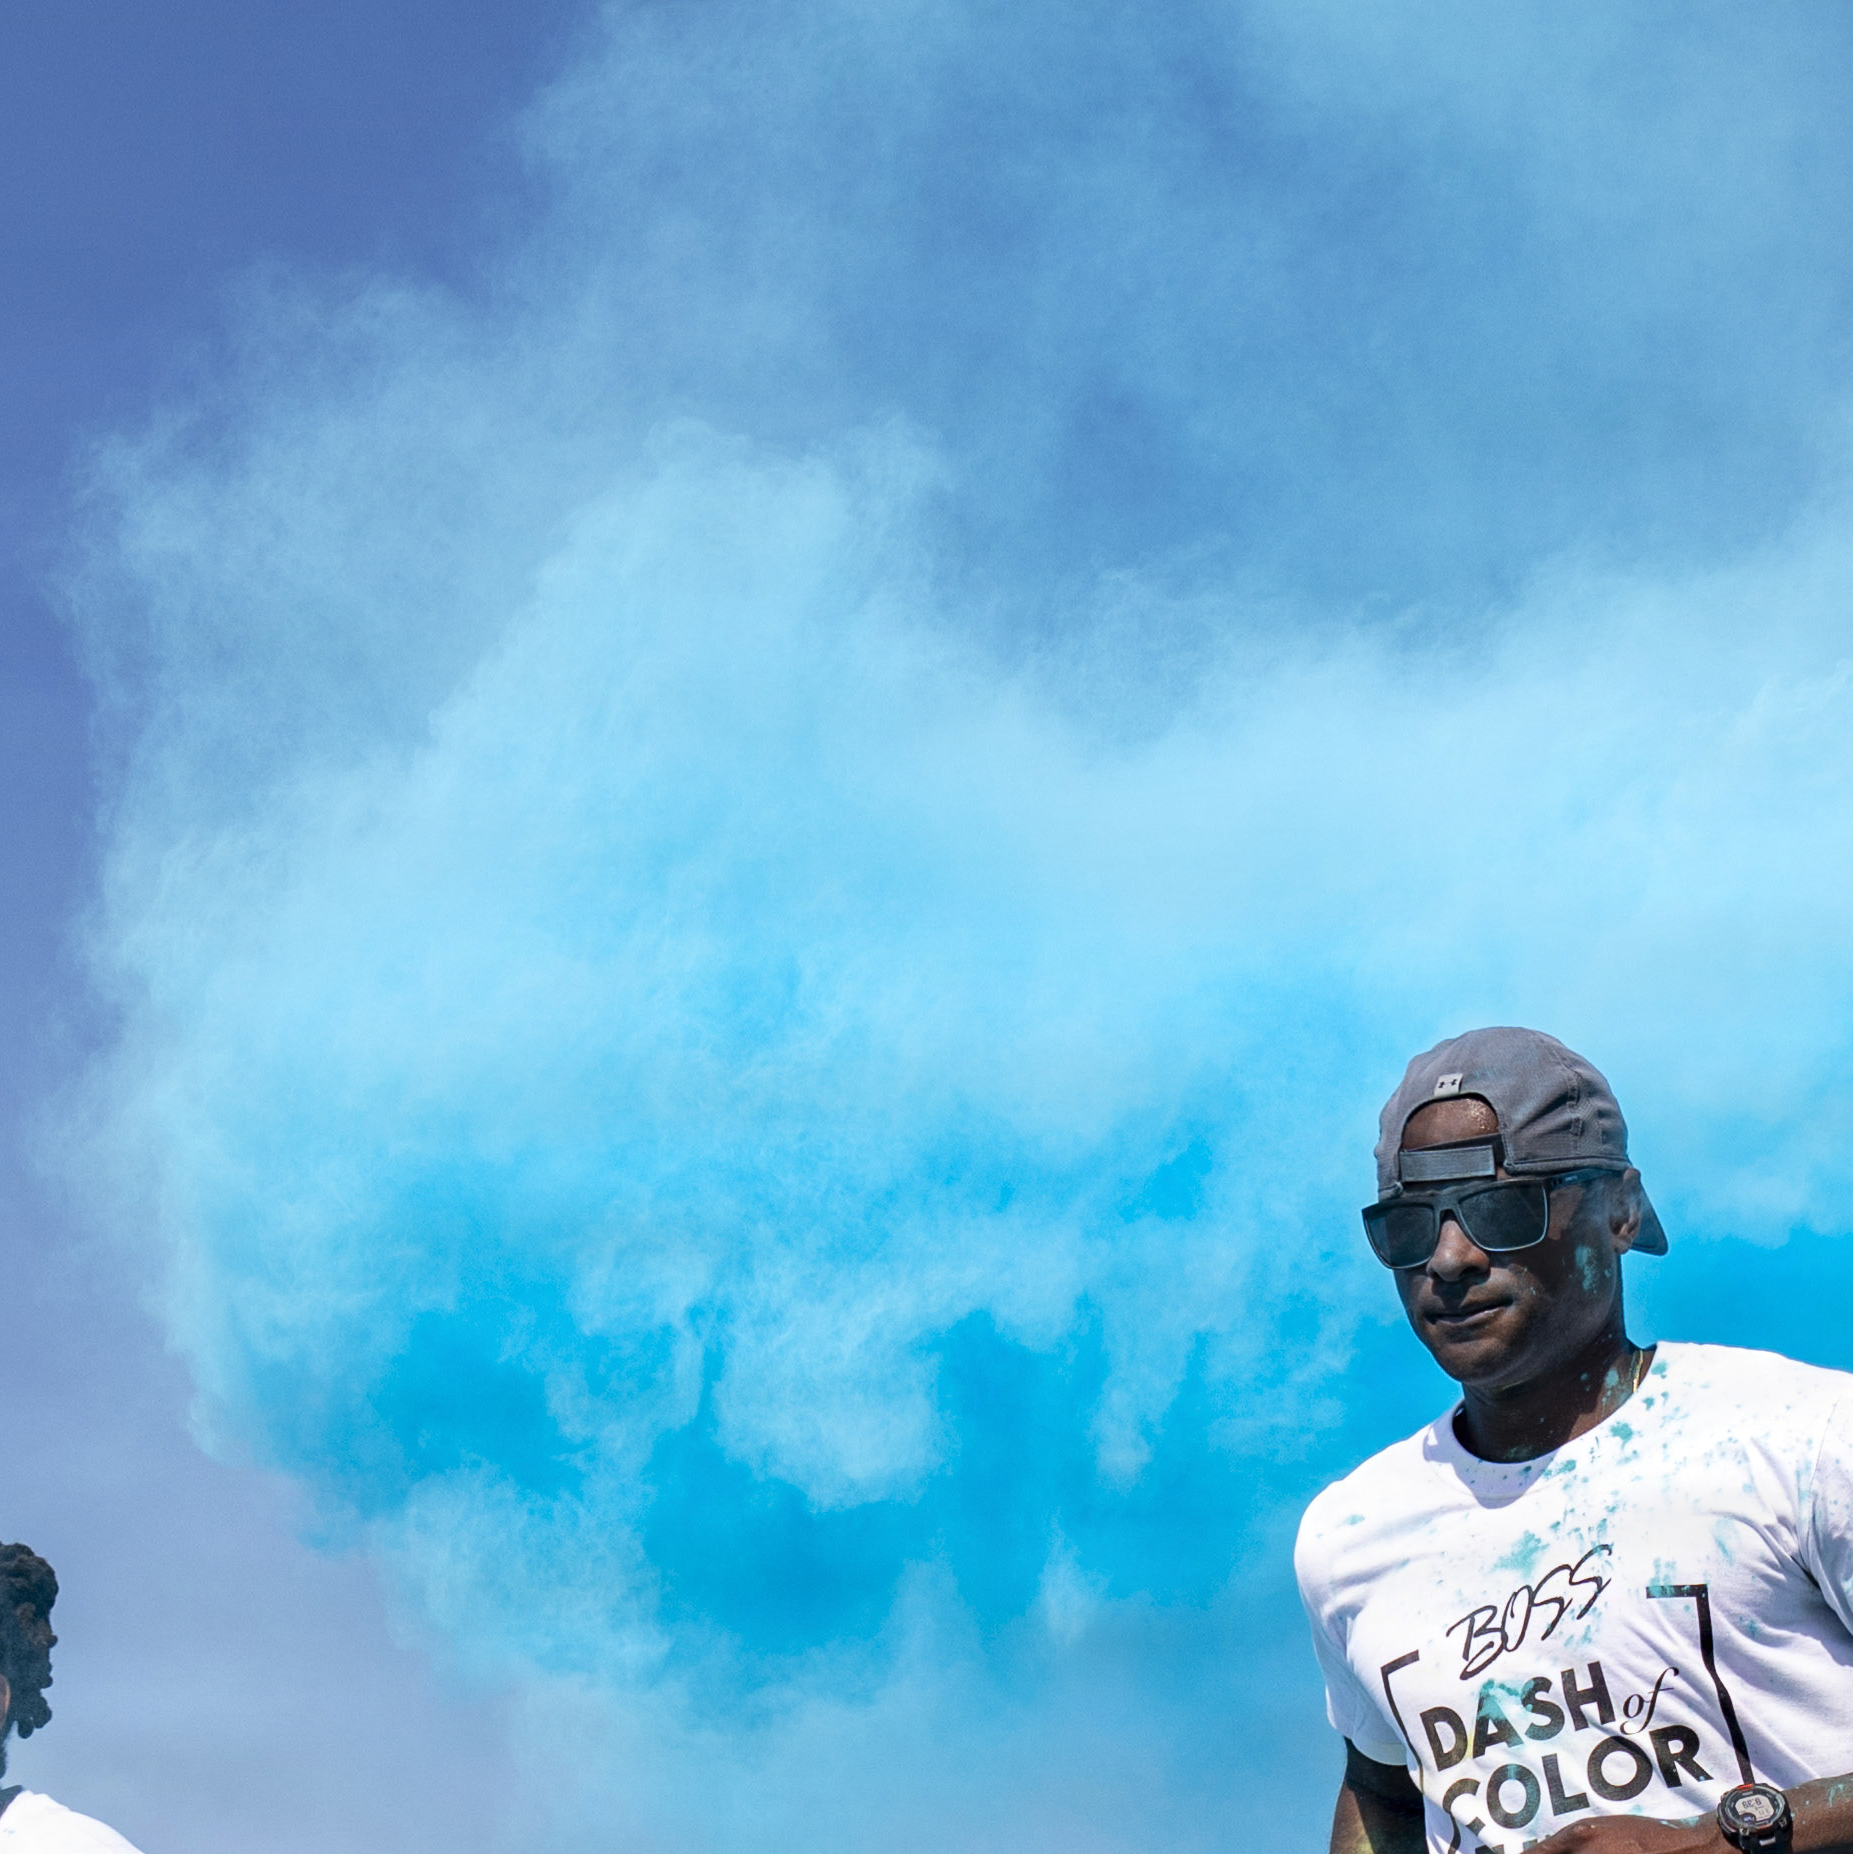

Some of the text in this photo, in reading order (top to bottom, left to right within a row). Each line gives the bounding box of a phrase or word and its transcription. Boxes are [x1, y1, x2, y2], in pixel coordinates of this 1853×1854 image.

[1445, 1543, 1613, 1681] BOSS
[1419, 1660, 1680, 1773] DASH of
[1441, 1724, 1715, 1830] COLOR
